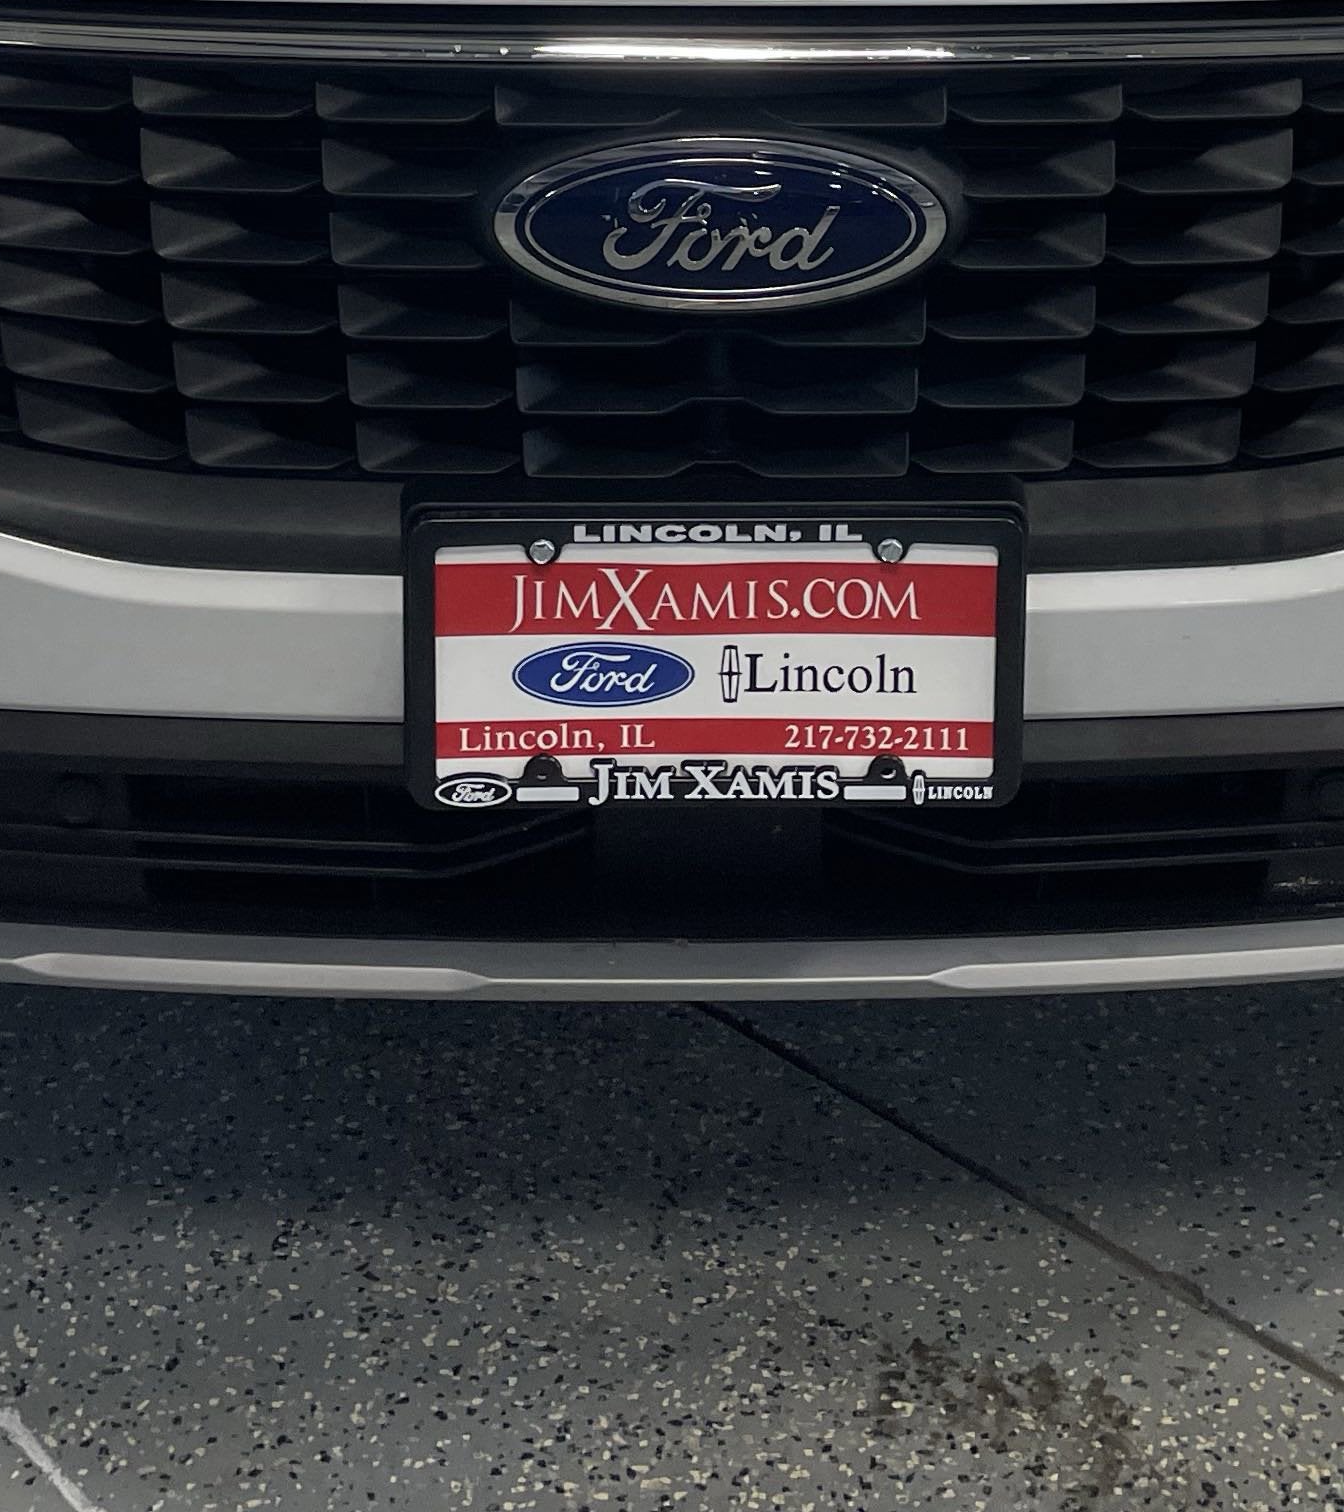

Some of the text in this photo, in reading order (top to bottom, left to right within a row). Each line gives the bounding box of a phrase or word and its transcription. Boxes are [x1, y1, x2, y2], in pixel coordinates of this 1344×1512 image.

[602, 178, 841, 271] Ford
[573, 523, 863, 543] LINCOLN, IL
[508, 568, 922, 633] JIMXAMIS.COM
[550, 650, 657, 695] Ford
[743, 653, 918, 695] Lincoln
[459, 723, 656, 752] Lincoln, IL
[784, 724, 969, 751] 217-732-2111
[451, 783, 495, 803] Ford
[588, 763, 840, 806] JIM XAMIS
[927, 785, 994, 800] LINCOLN
